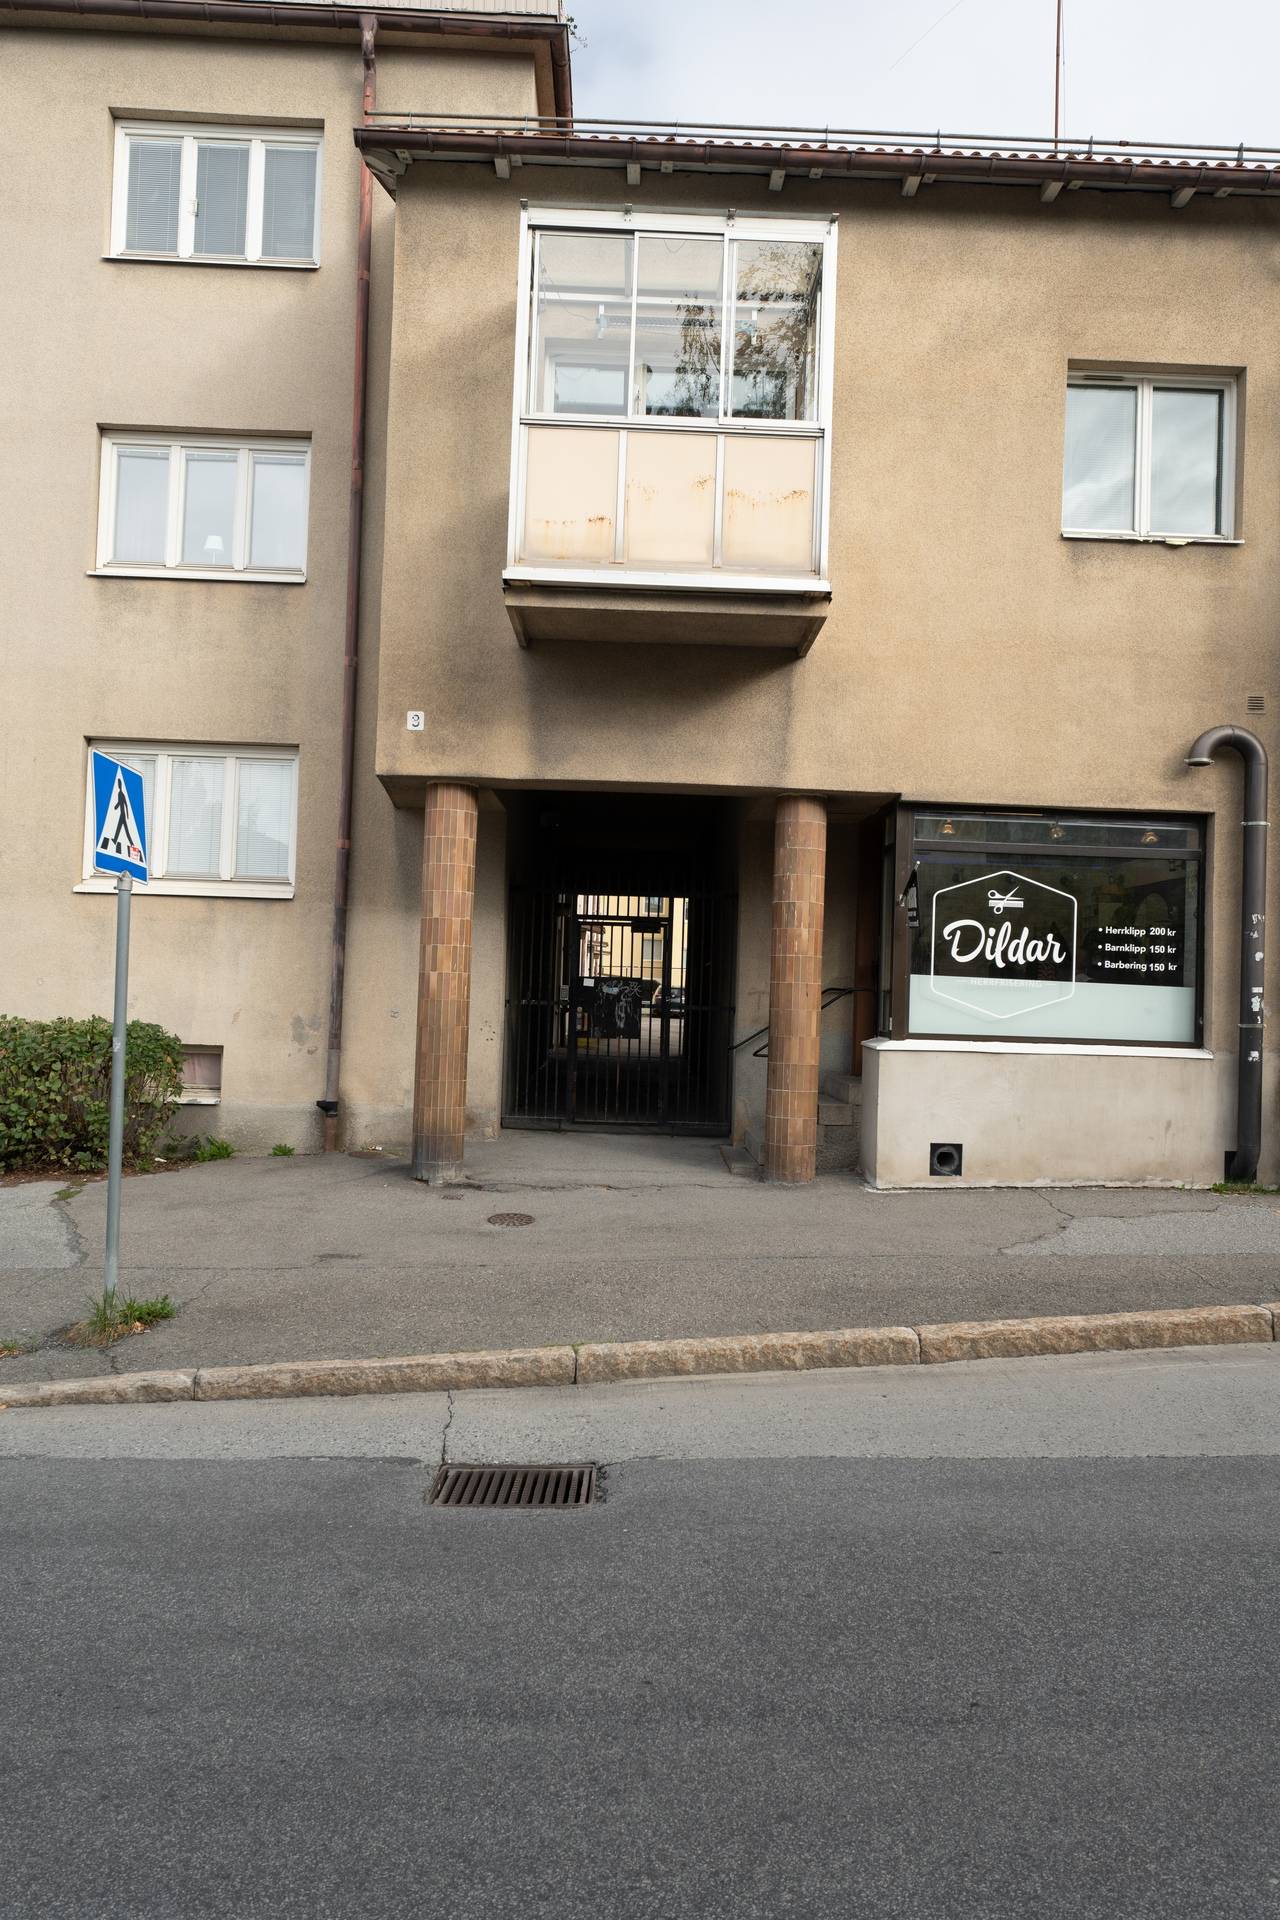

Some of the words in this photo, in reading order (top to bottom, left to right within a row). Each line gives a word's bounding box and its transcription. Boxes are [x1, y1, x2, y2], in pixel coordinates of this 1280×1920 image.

[1105, 926, 1146, 937] Herrklipp
[1149, 927, 1165, 936] 200
[1167, 928, 1176, 937] kr
[943, 919, 1066, 968] Dildar
[1104, 943, 1146, 954] Barnklipp
[1149, 945, 1165, 954] 150
[1167, 945, 1176, 954] kr
[1104, 960, 1147, 972] Barbering
[1149, 963, 1165, 972] 150
[1168, 962, 1177, 971] kr
